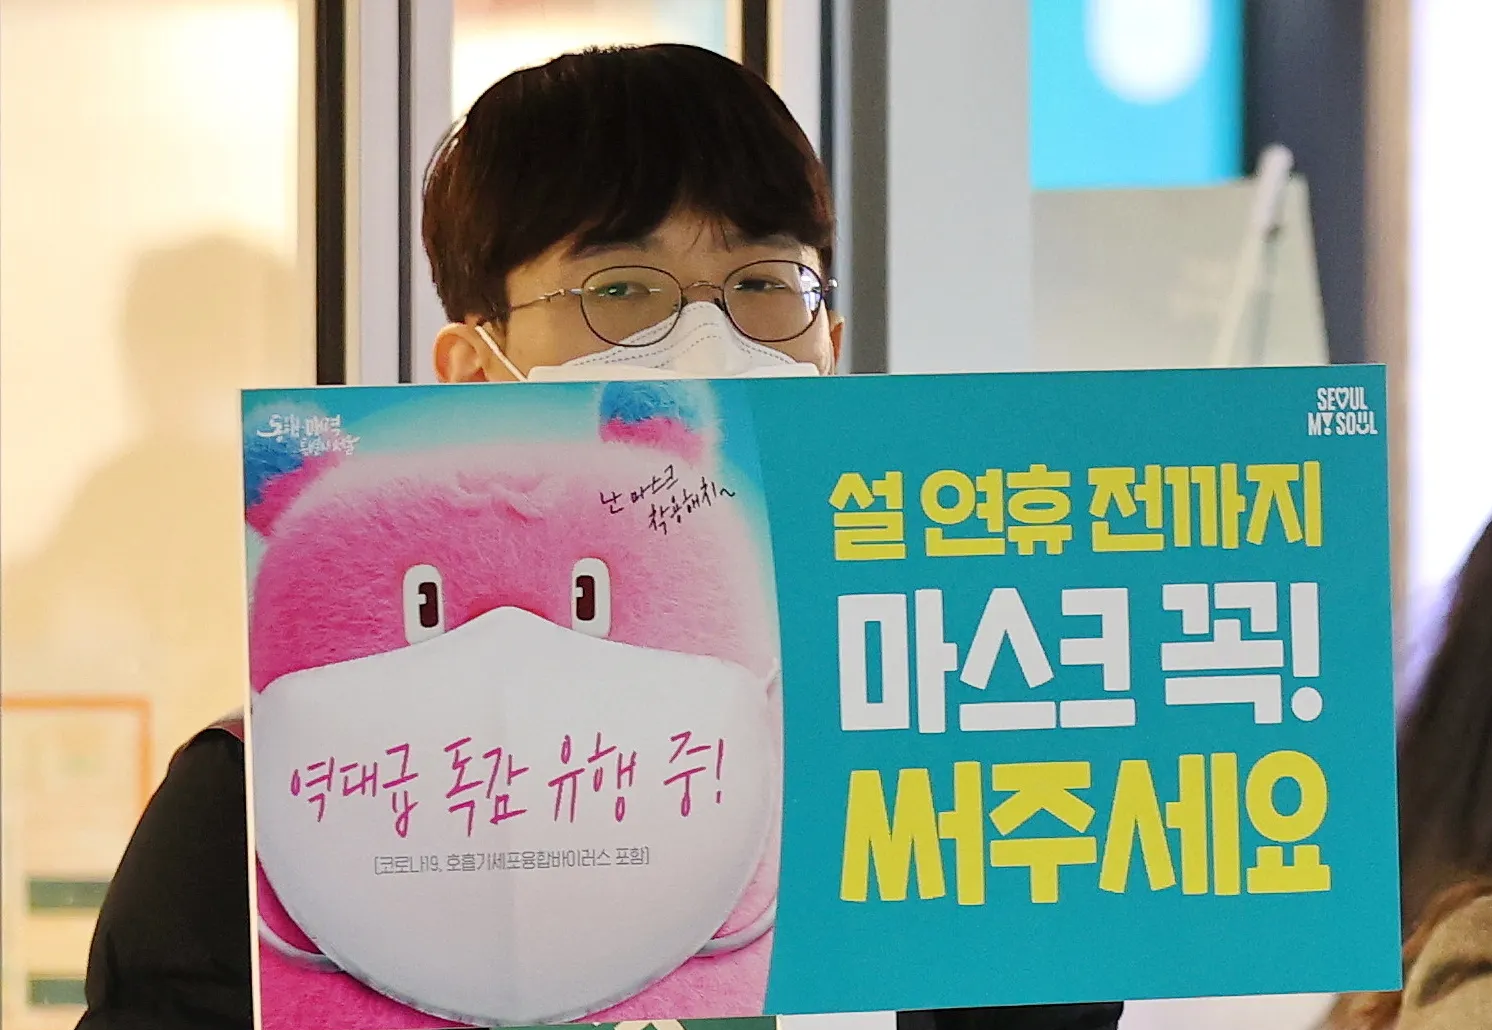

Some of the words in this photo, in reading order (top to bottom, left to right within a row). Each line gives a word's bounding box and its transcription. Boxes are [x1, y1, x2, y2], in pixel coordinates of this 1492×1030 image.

[1317, 386, 1369, 411] SEOUL
[1335, 410, 1379, 436] SOUL
[599, 491, 624, 514] 난
[630, 464, 679, 503] 마스크
[828, 471, 907, 561] 설
[920, 464, 1073, 556] 연휴
[1088, 461, 1323, 552] 전까지
[837, 587, 1136, 734] 마스크
[1161, 582, 1324, 724] 꼭!
[290, 743, 419, 838] 역대급
[443, 737, 530, 837] 독감
[547, 732, 637, 823] 유행
[664, 731, 724, 817] 중!
[446, 849, 612, 872] 호흡기세포융합바이러스
[615, 846, 650, 866] 포함]
[839, 750, 1332, 906] 써주세요
